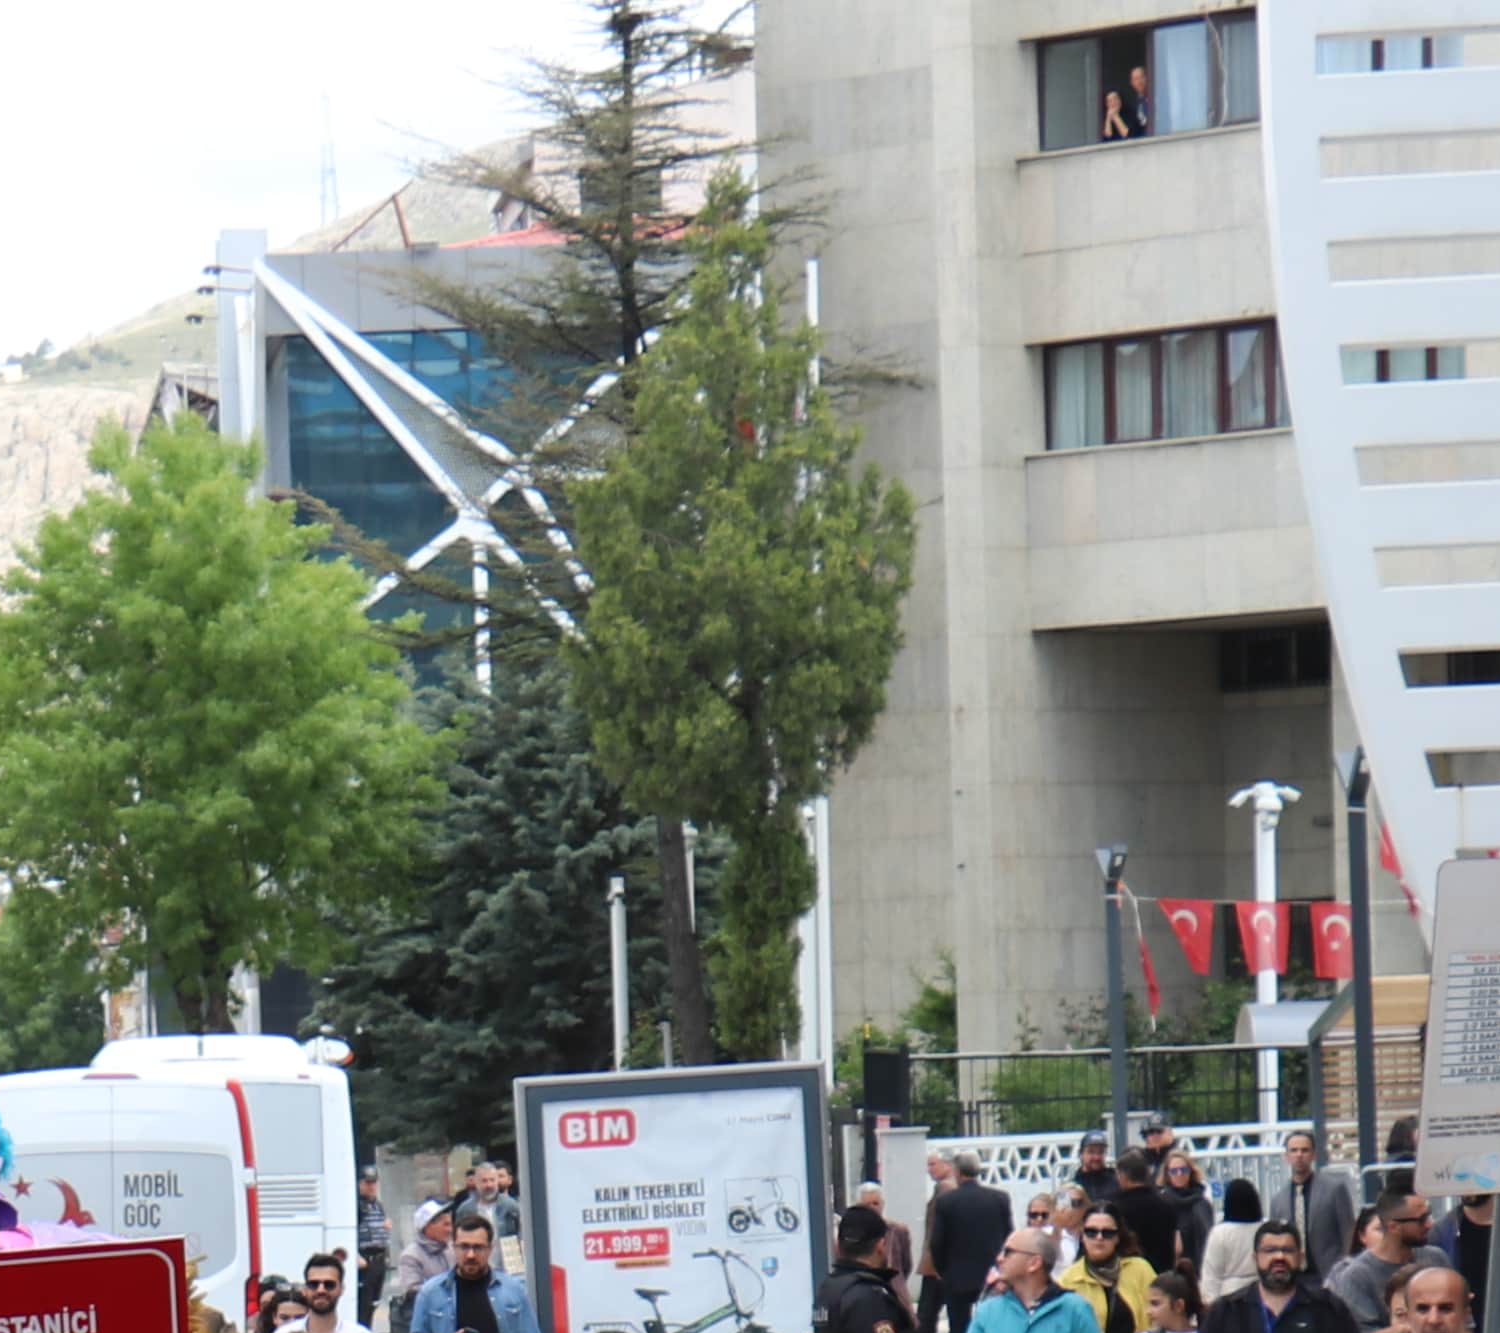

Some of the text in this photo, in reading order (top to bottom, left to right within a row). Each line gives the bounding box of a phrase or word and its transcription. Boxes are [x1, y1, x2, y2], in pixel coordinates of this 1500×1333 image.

[124, 1170, 183, 1198] MOBİL
[594, 1178, 705, 1203] KALIN TEKERLEKLİ
[124, 1200, 161, 1229] GÖÇ
[582, 1200, 706, 1224] ELEKTRİKLİ BİSİKLET
